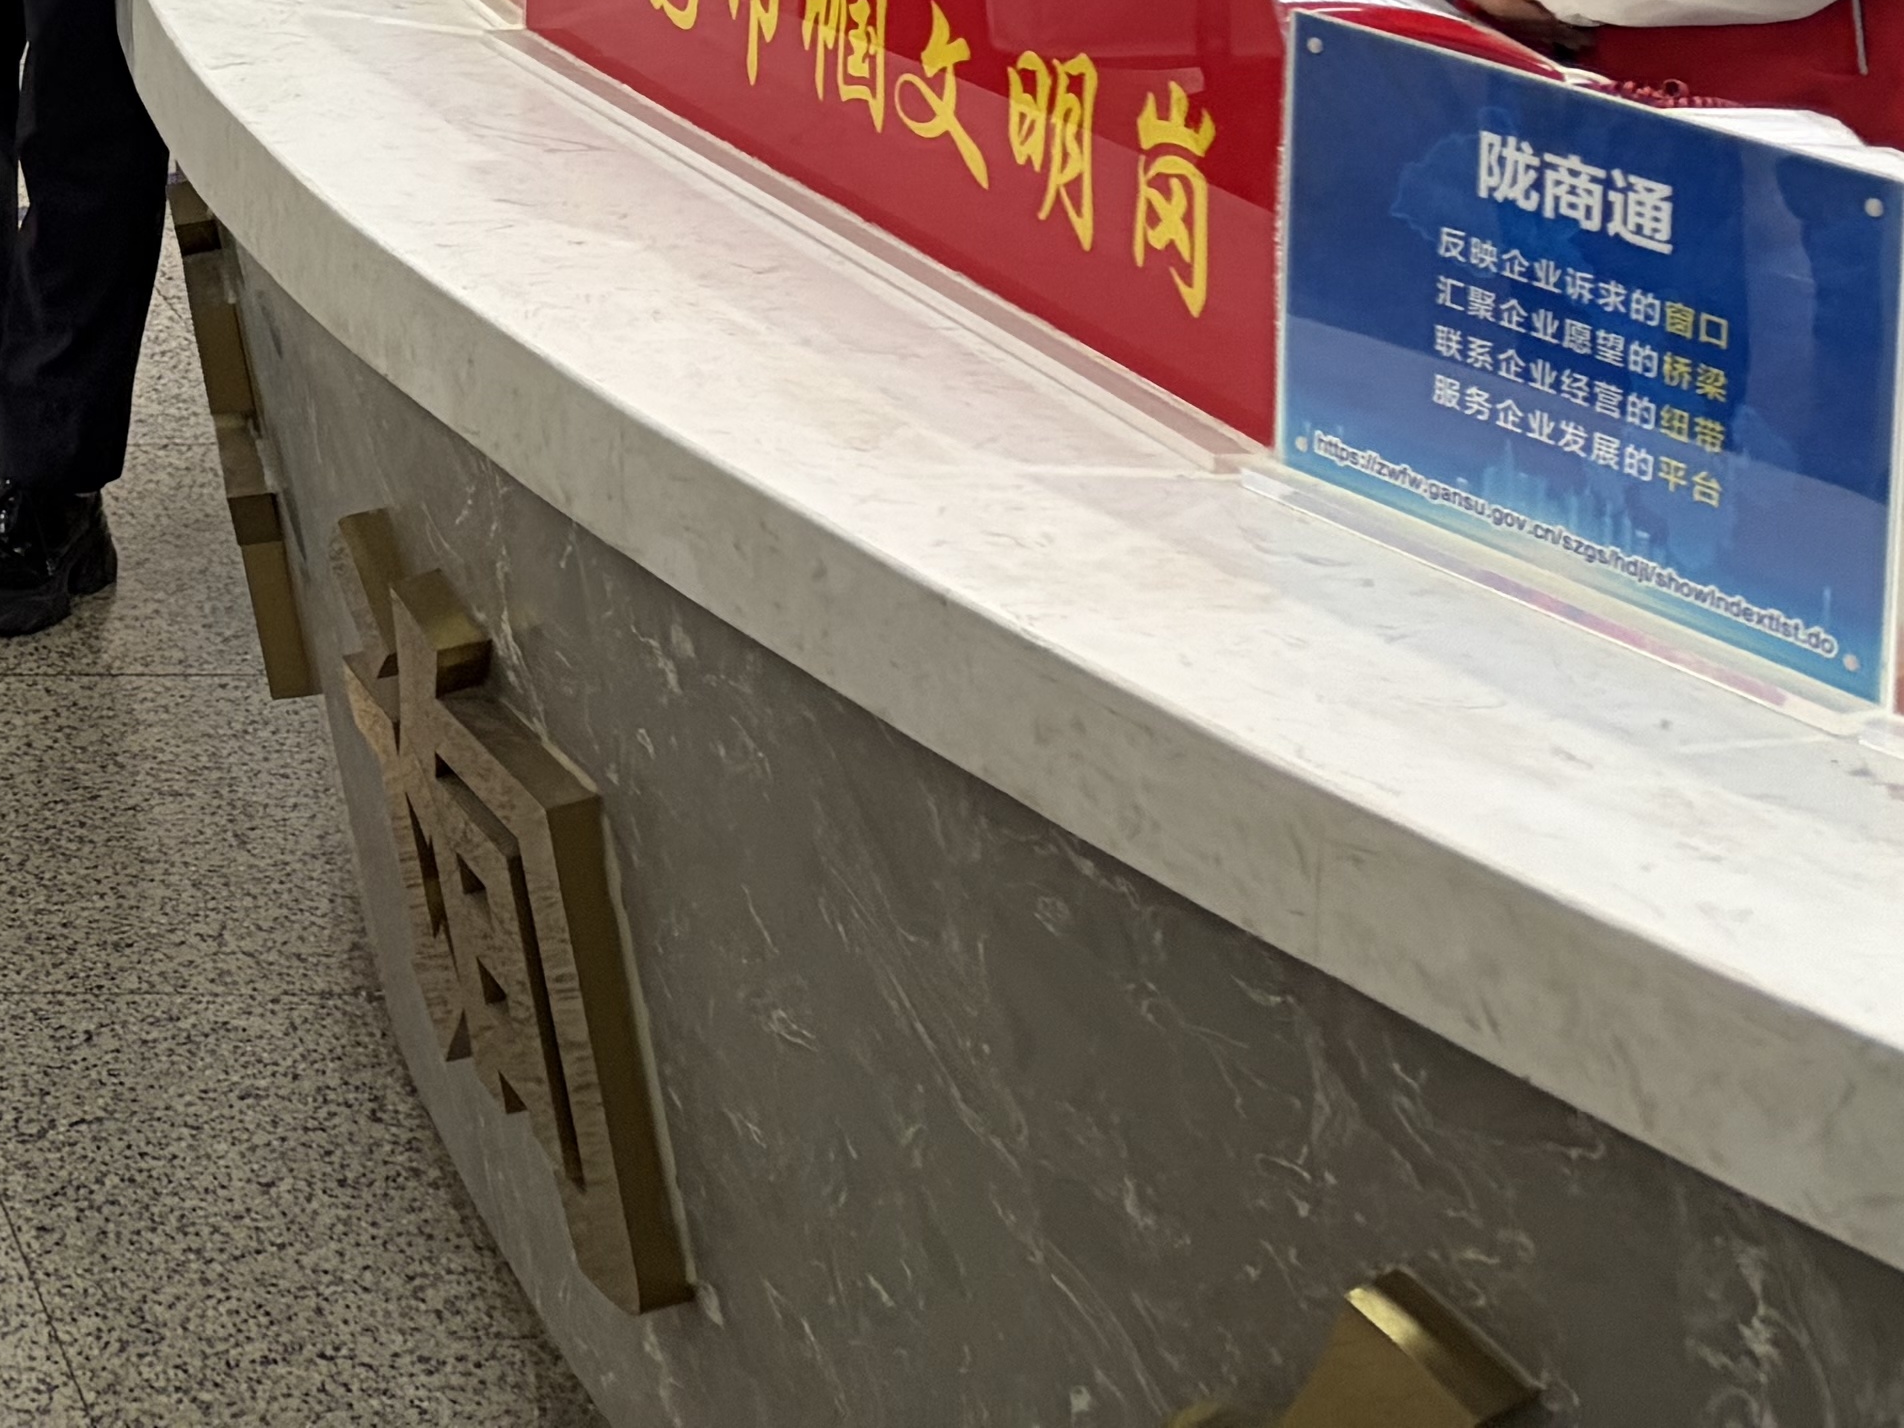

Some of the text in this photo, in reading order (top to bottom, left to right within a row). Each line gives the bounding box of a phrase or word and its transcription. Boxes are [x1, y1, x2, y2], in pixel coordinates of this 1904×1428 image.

[1475, 129, 1675, 256] 陇商通
[1435, 273, 1729, 405] 汇聚企业愿望的桥梁
[1437, 226, 1730, 352] 反映企业诉求的窗口
[1432, 372, 1724, 510] 服务企业发展的平台
[1433, 322, 1727, 455] 联系企业经营的纽带
